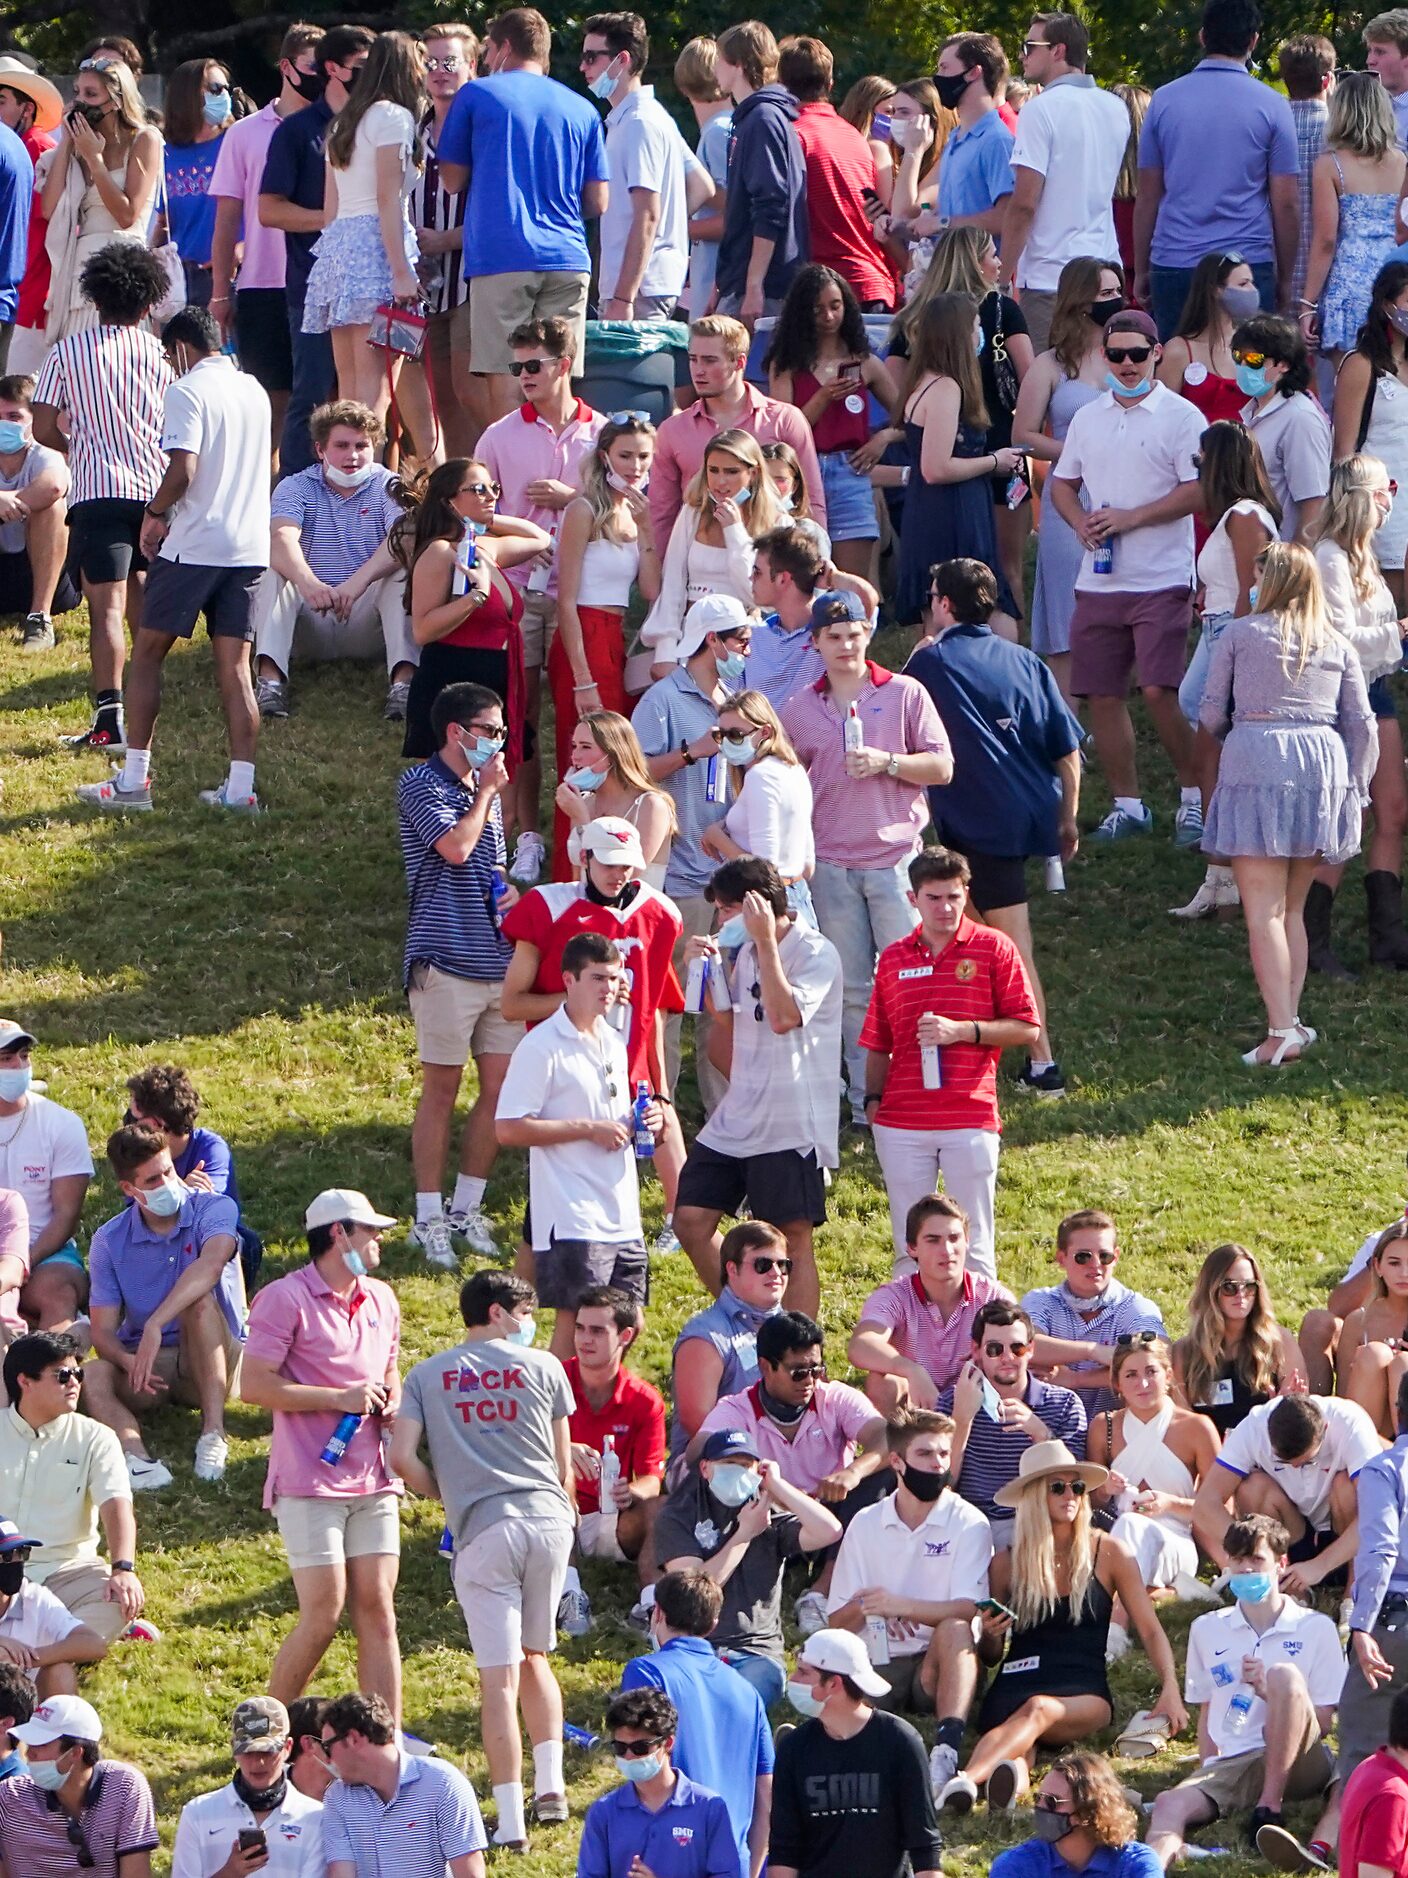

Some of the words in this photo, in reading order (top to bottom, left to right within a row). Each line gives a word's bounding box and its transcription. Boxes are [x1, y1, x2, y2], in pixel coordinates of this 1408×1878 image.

[442, 1367, 526, 1392] FCK
[454, 1399, 518, 1424] TCU
[1282, 1640, 1303, 1650] SMU
[804, 1773, 880, 1809] SMU
[672, 1826, 693, 1838] SMU
